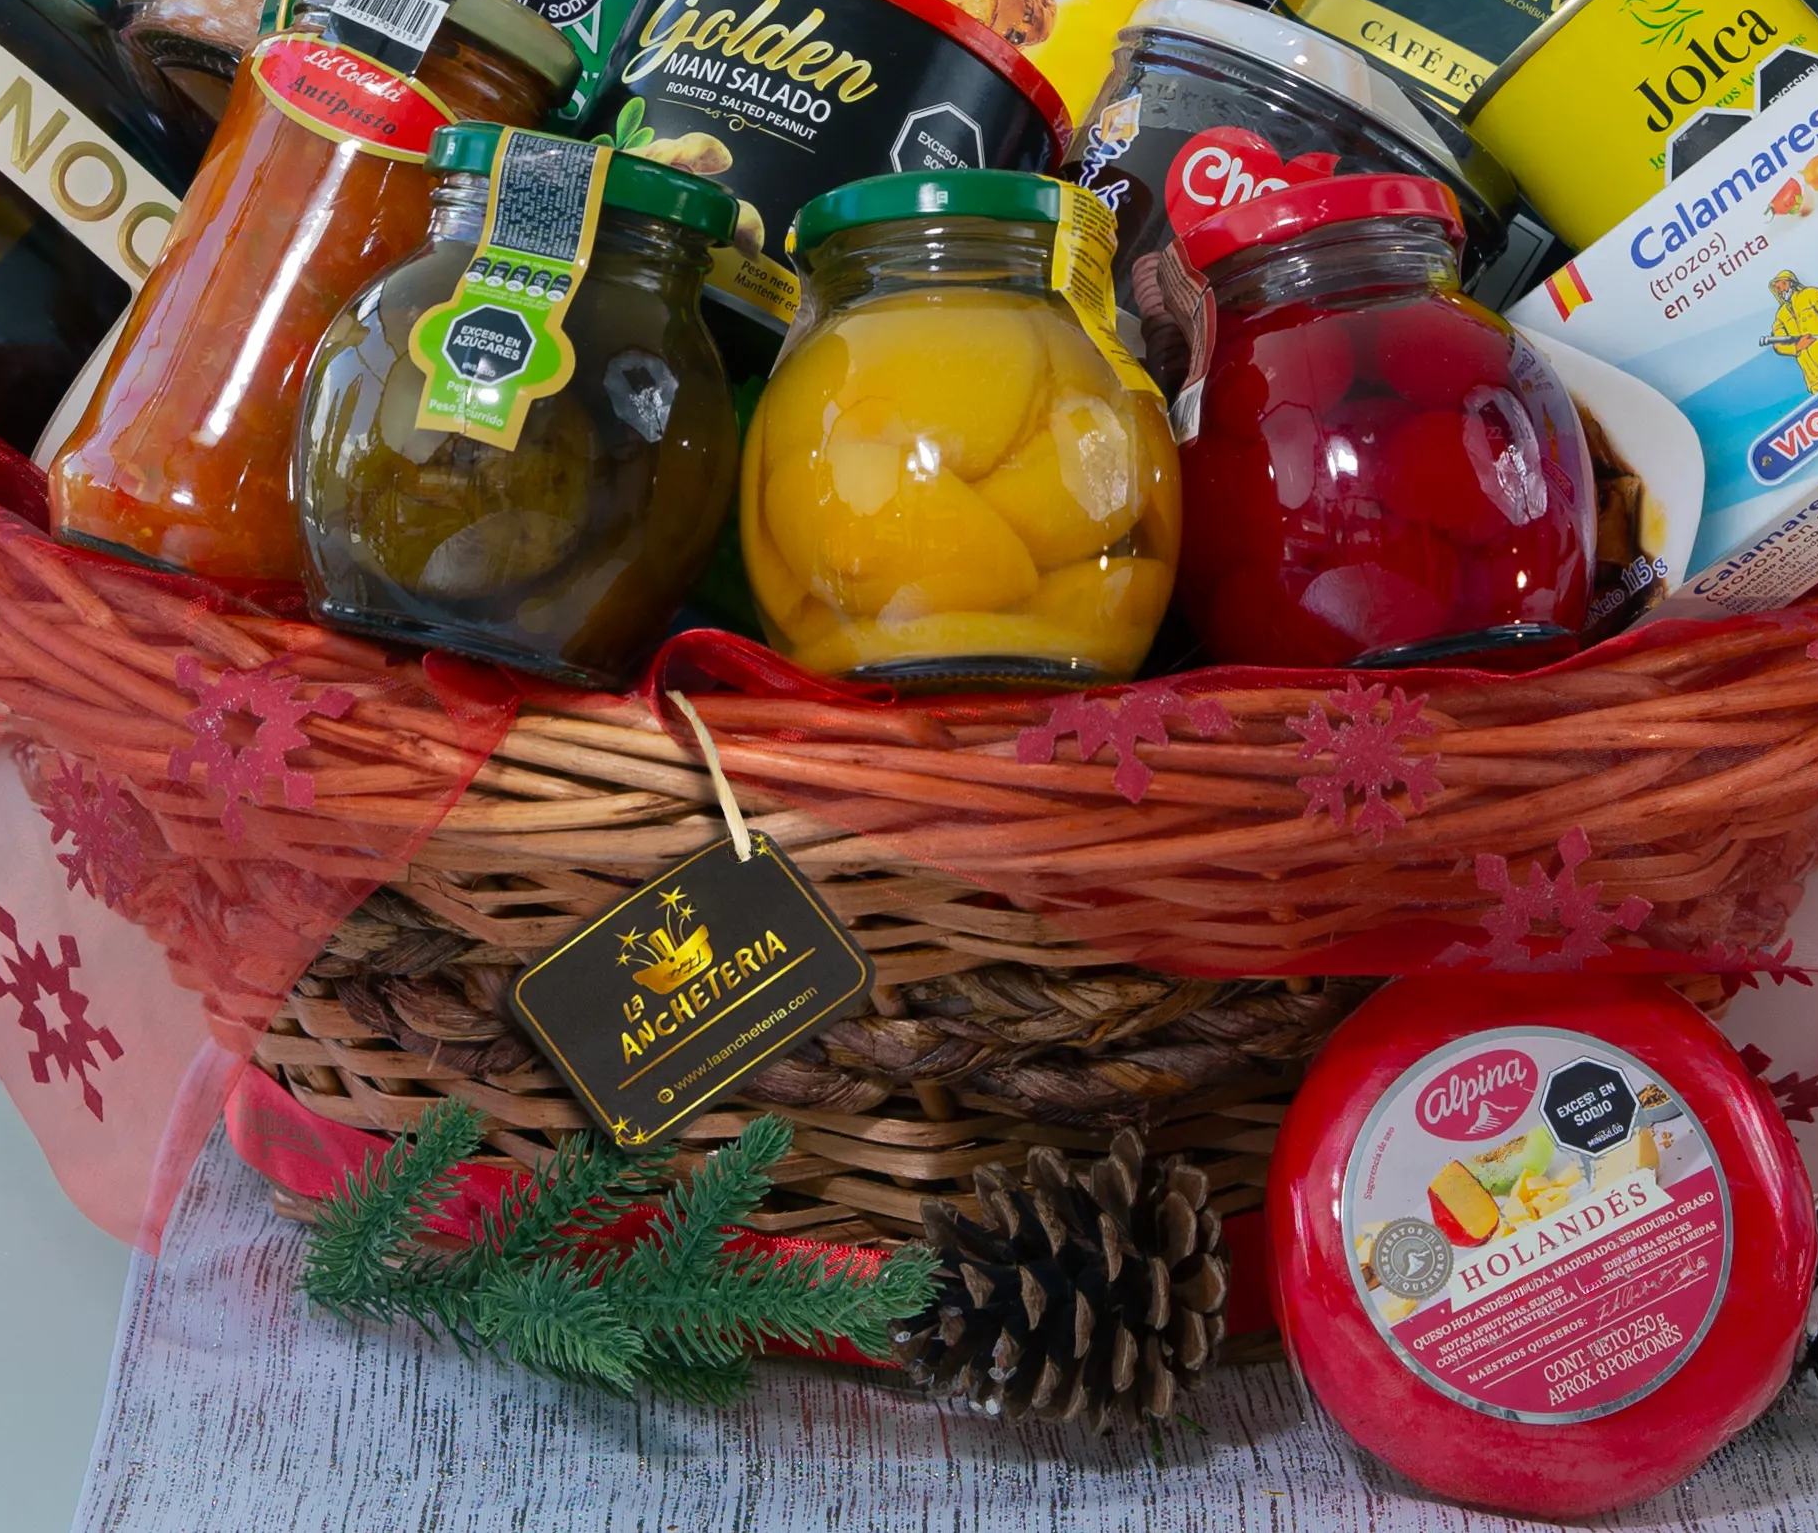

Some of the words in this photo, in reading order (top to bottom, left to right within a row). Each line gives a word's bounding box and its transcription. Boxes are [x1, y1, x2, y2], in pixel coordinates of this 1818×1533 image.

[1360, 20, 1445, 73] CAFÉ
[1634, 6, 1778, 133] Jolca
[287, 75, 397, 135] Antipasto
[663, 51, 727, 92] MANI
[726, 67, 832, 125] SALADO
[667, 81, 714, 105] ROASTED
[720, 95, 765, 120] SALTED
[766, 107, 818, 140] PEANUT
[734, 273, 785, 305] Mantener
[741, 261, 767, 280] Peso
[770, 276, 794, 294] neto
[1650, 232, 1727, 301] (trozos)
[1664, 296, 1690, 320] en
[1693, 274, 1717, 300] su
[1718, 235, 1768, 276] tinta
[453, 334, 521, 361] AZÚCARES
[461, 325, 504, 343] EXCESO
[504, 338, 521, 349] EN
[619, 929, 788, 1064] ANCHETERIA
[623, 993, 645, 1024] La
[674, 985, 819, 1092] www.laancheteria.com
[1413, 1323, 1451, 1350] QUESO
[1619, 1212, 1677, 1246] SEMIDURO,
[1677, 1191, 1714, 1217] GRASO
[1459, 1182, 1648, 1293] HOLANDÉS
[1439, 1335, 1468, 1355] NOTAS
[1529, 1286, 1564, 1312] SUAVES
[1468, 1351, 1527, 1382] MAESTROS
[1528, 1317, 1588, 1354] QUESEROS:
[1548, 1374, 1600, 1406] APROX.
[1599, 1367, 1608, 1381] 8
[1607, 1325, 1683, 1376] PORCIONES
